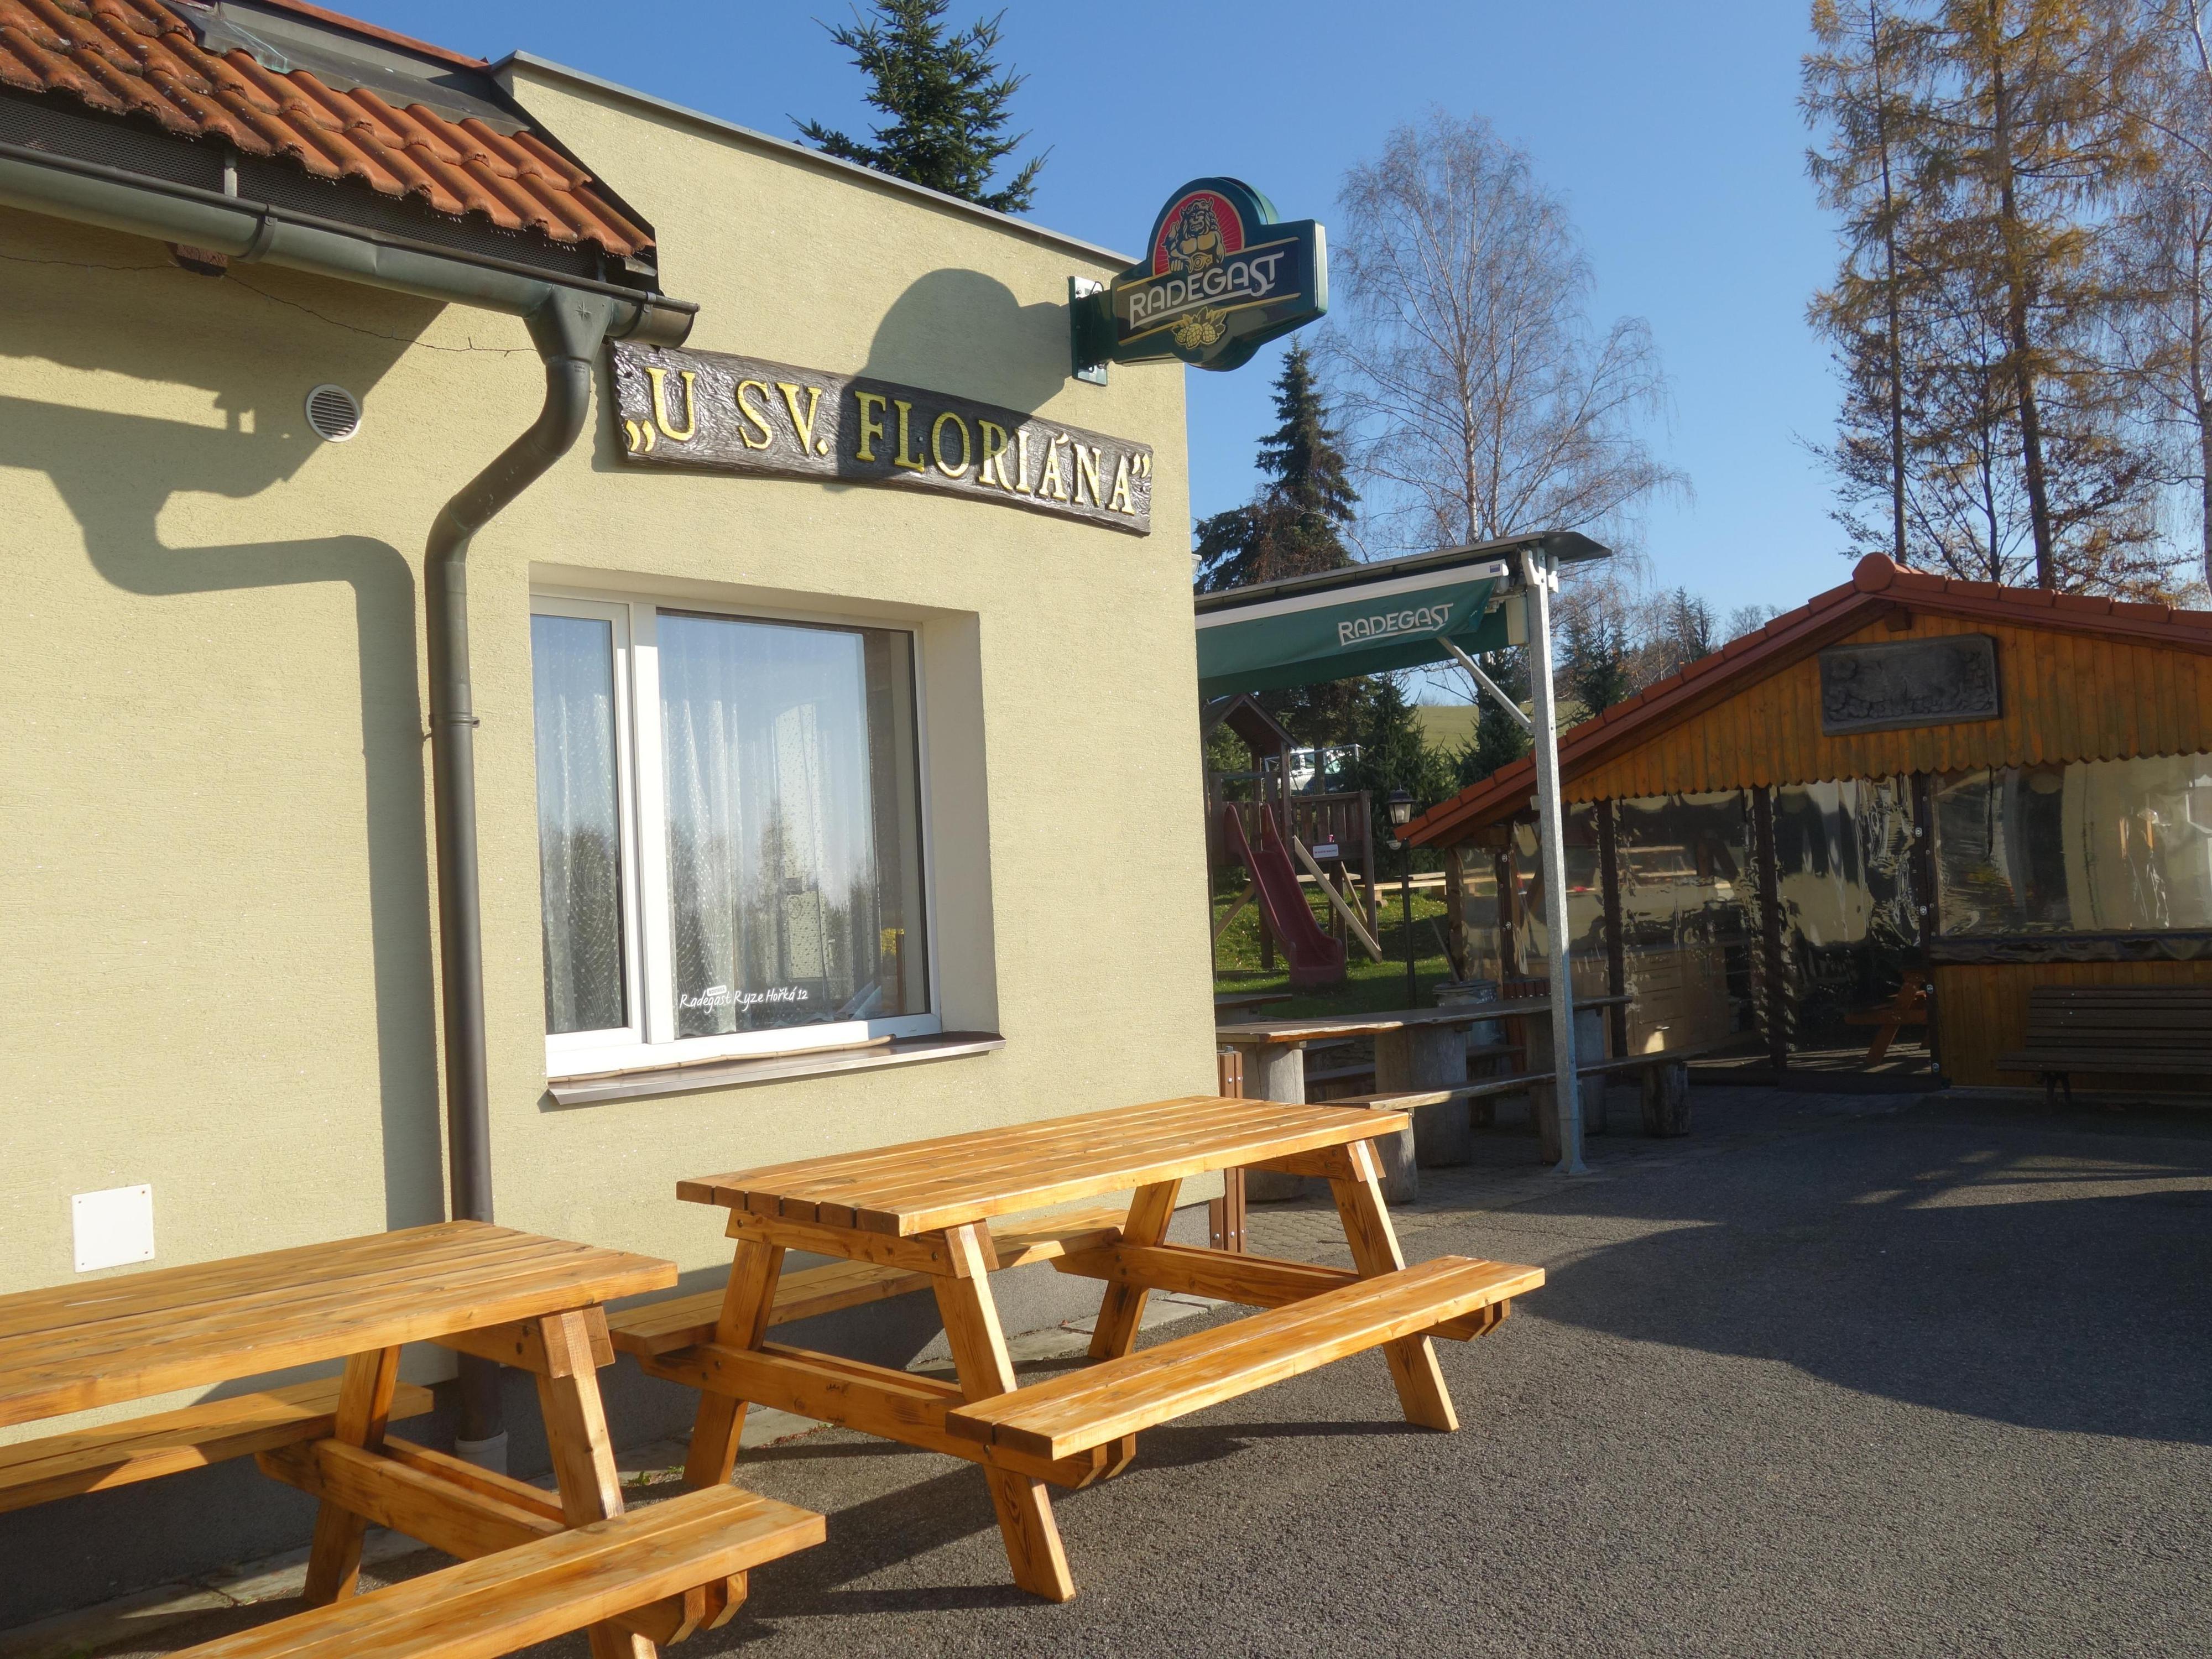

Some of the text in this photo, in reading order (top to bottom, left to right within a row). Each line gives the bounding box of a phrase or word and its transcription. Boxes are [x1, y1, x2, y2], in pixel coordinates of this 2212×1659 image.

[1129, 251, 1285, 330] RADEGAST
[737, 380, 829, 457] SV.
[1337, 602, 1454, 646] RADEGAST
[680, 986, 808, 1014] Radegast Ryze Hořká 12
